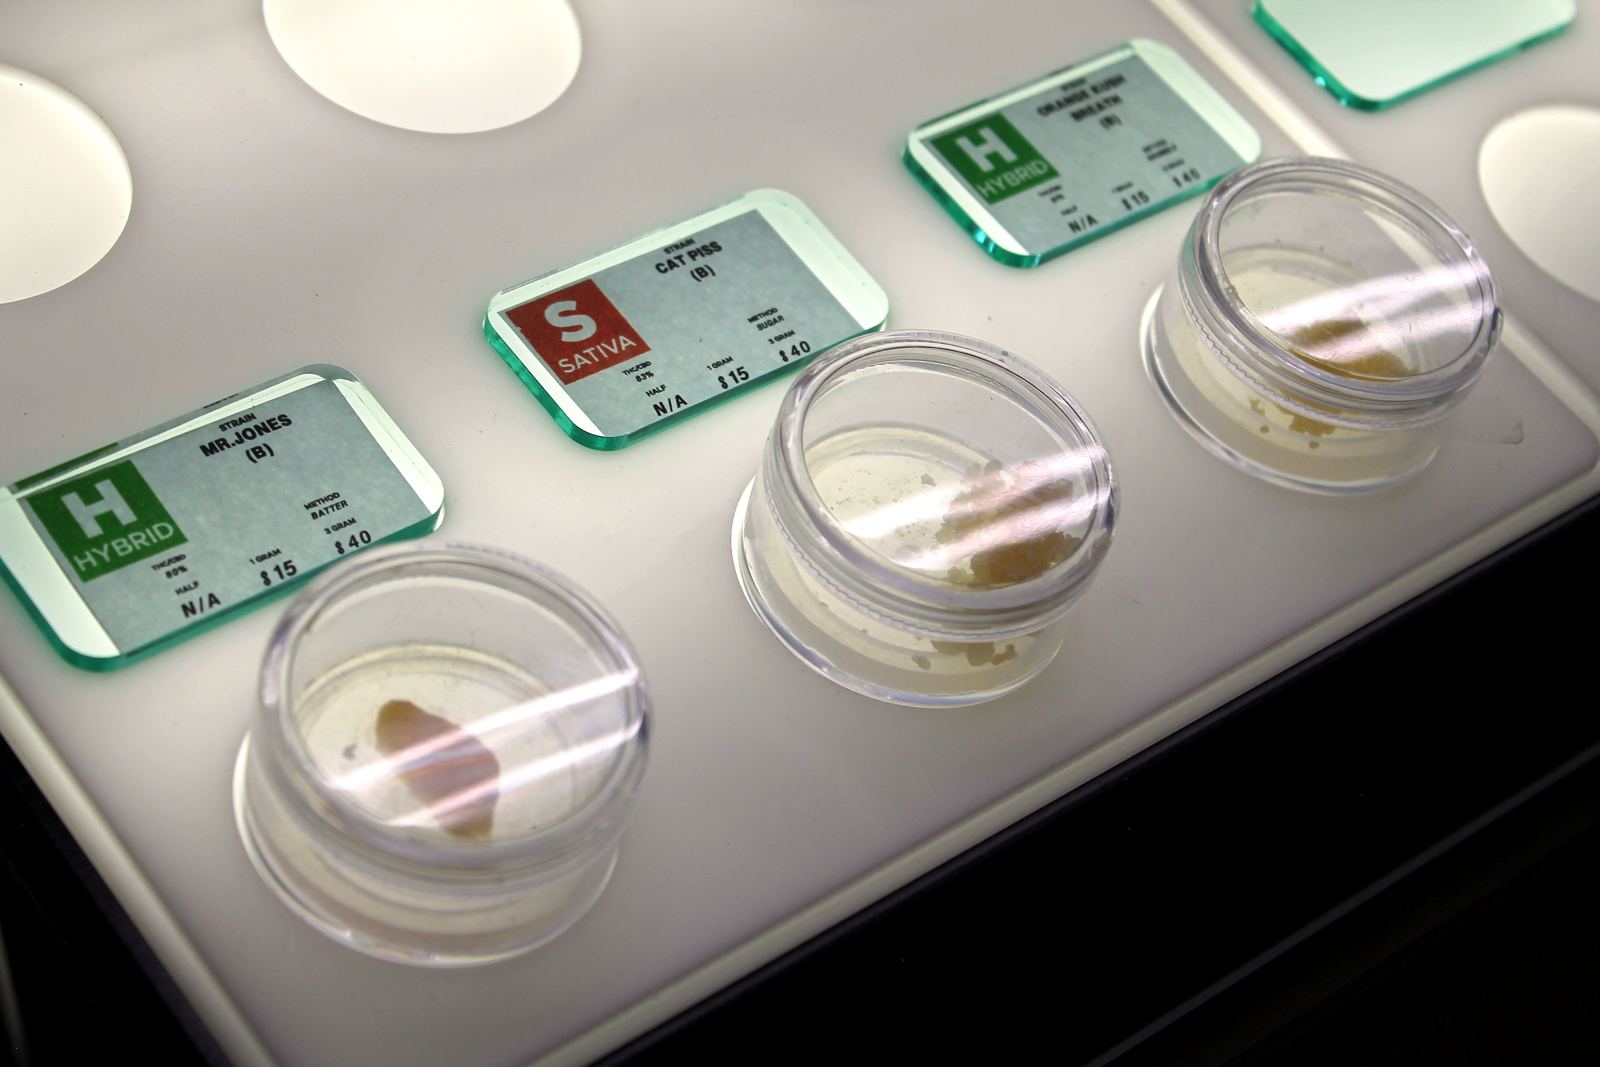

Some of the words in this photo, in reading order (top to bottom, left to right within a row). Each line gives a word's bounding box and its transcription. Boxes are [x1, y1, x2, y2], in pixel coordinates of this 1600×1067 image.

[956, 127, 1018, 173] H
[976, 160, 1049, 198] HYBRID
[1068, 214, 1098, 233] N/A
[663, 238, 695, 254] STRAIN
[655, 254, 686, 274] CAT
[687, 241, 722, 261] PISS
[690, 264, 716, 282] (B)
[544, 300, 597, 342] S
[747, 307, 778, 323] METHOD
[756, 314, 785, 331] SUGAR
[774, 330, 796, 342] GRAM
[558, 335, 637, 373] SATIVA
[711, 356, 734, 369] GRAM
[622, 360, 652, 376] THC/CBD
[645, 384, 667, 398] HALF
[653, 394, 688, 416] N/A
[218, 412, 257, 432] STRAIN
[199, 414, 293, 457] MR.JONES
[245, 443, 274, 464] (B)
[60, 479, 138, 539] H
[303, 492, 340, 510] METHOD
[310, 499, 349, 520] BATTER
[331, 517, 357, 532] GRAM
[73, 522, 174, 572] HYBRID
[255, 548, 283, 563] GRAM
[175, 580, 199, 596] HALF
[180, 592, 221, 618] N/A
